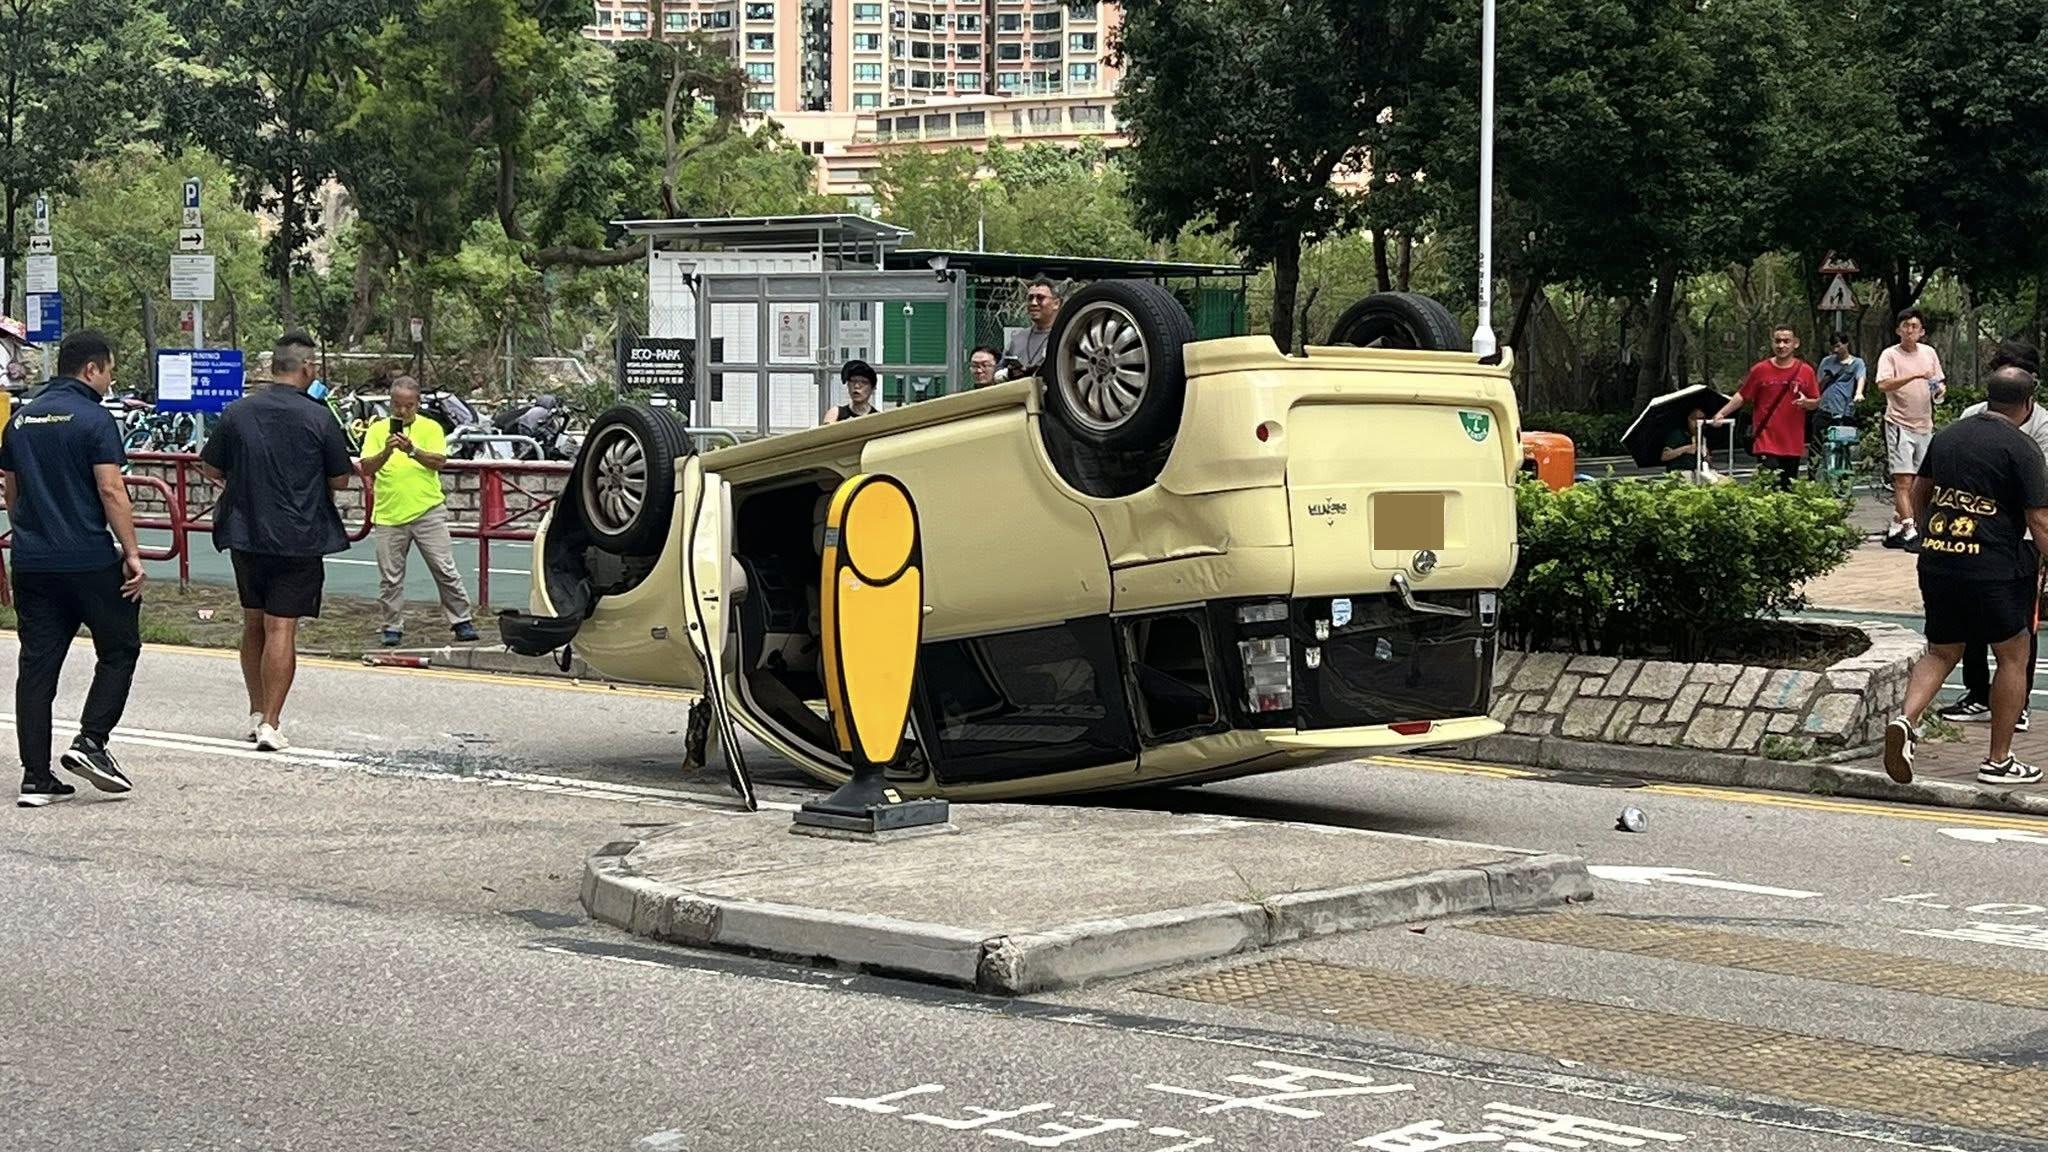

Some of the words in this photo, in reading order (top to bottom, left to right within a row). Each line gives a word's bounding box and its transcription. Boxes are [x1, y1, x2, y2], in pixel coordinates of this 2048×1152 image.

[185, 184, 197, 206] P
[36, 200, 44, 219] P
[631, 348, 681, 361] ECO-PARK
[1921, 537, 1966, 553] APOLLO
[1967, 543, 1980, 554] 11
